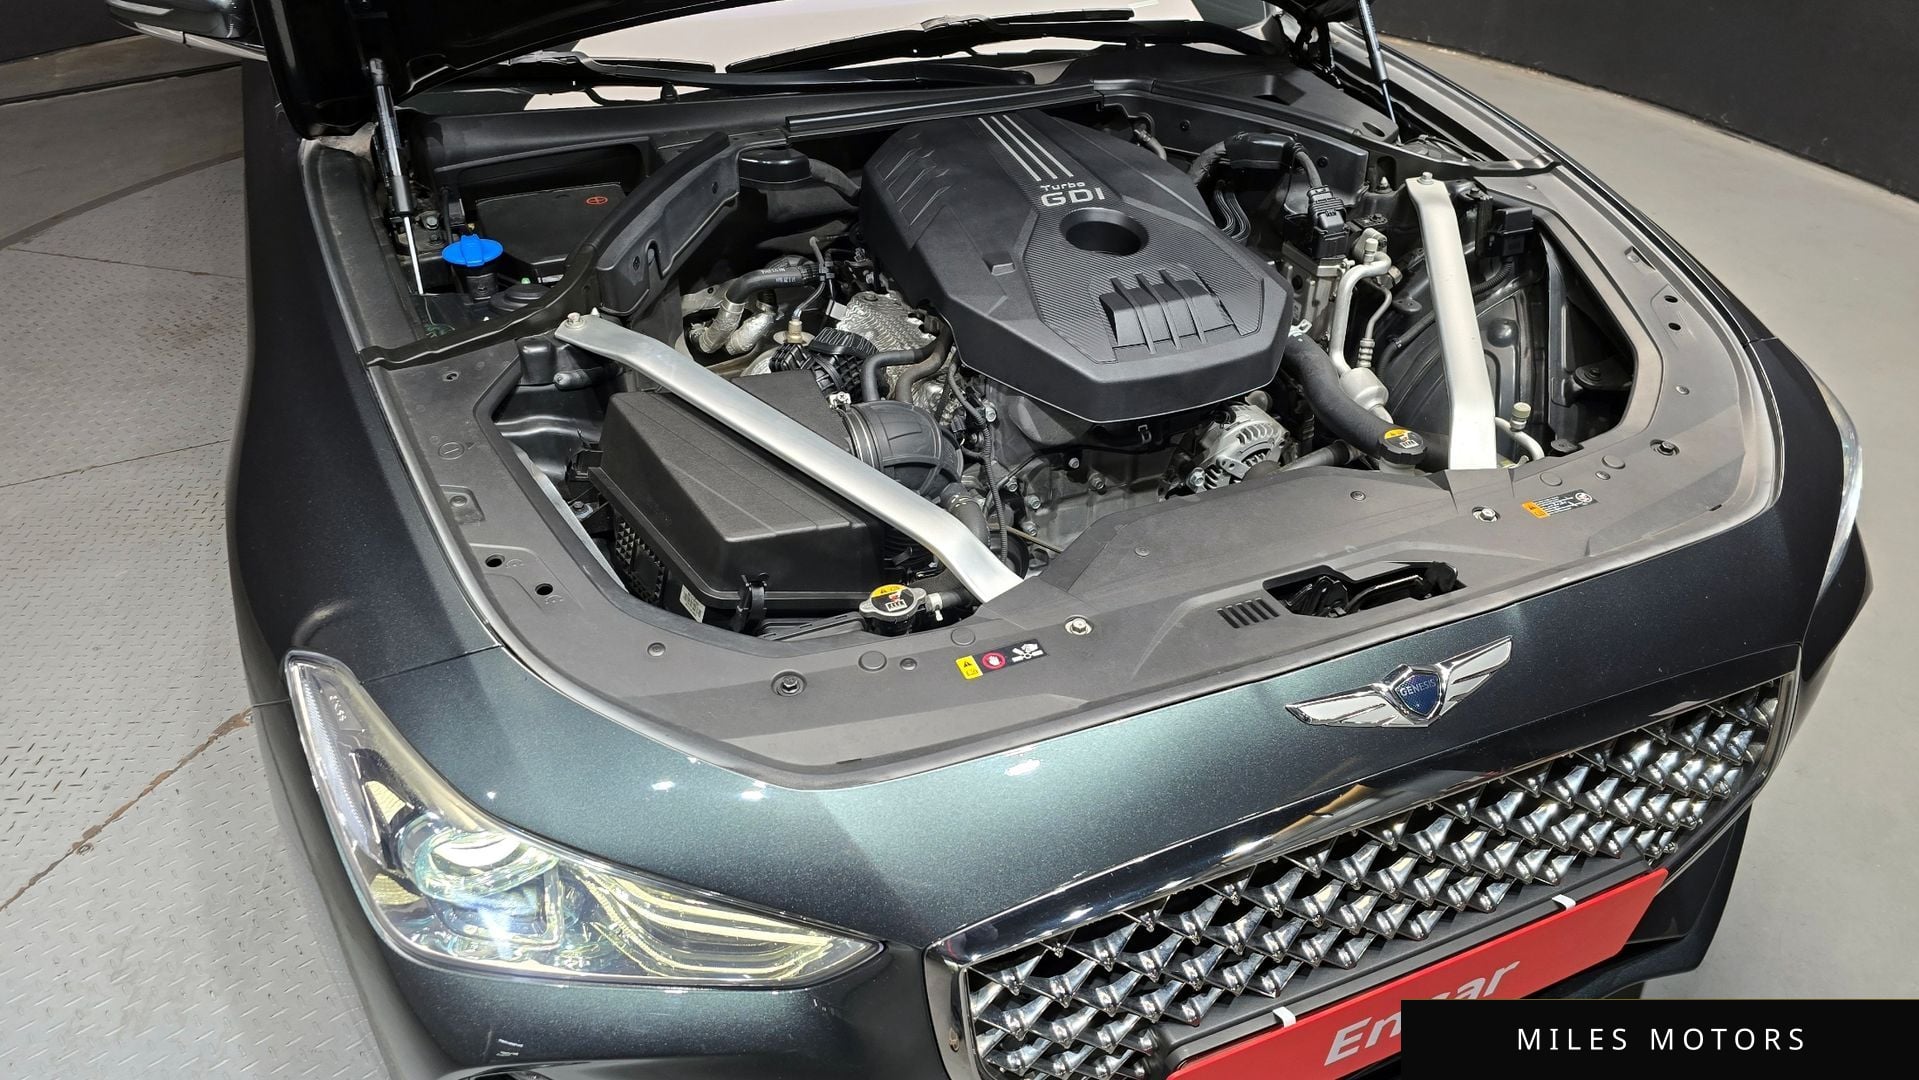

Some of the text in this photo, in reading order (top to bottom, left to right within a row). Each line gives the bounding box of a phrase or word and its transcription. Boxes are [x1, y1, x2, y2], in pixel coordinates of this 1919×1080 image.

[1040, 182, 1085, 191] Turbo
[1041, 187, 1105, 206] GDI
[1400, 678, 1436, 697] GENESIS
[1323, 960, 1521, 1067] Enar
